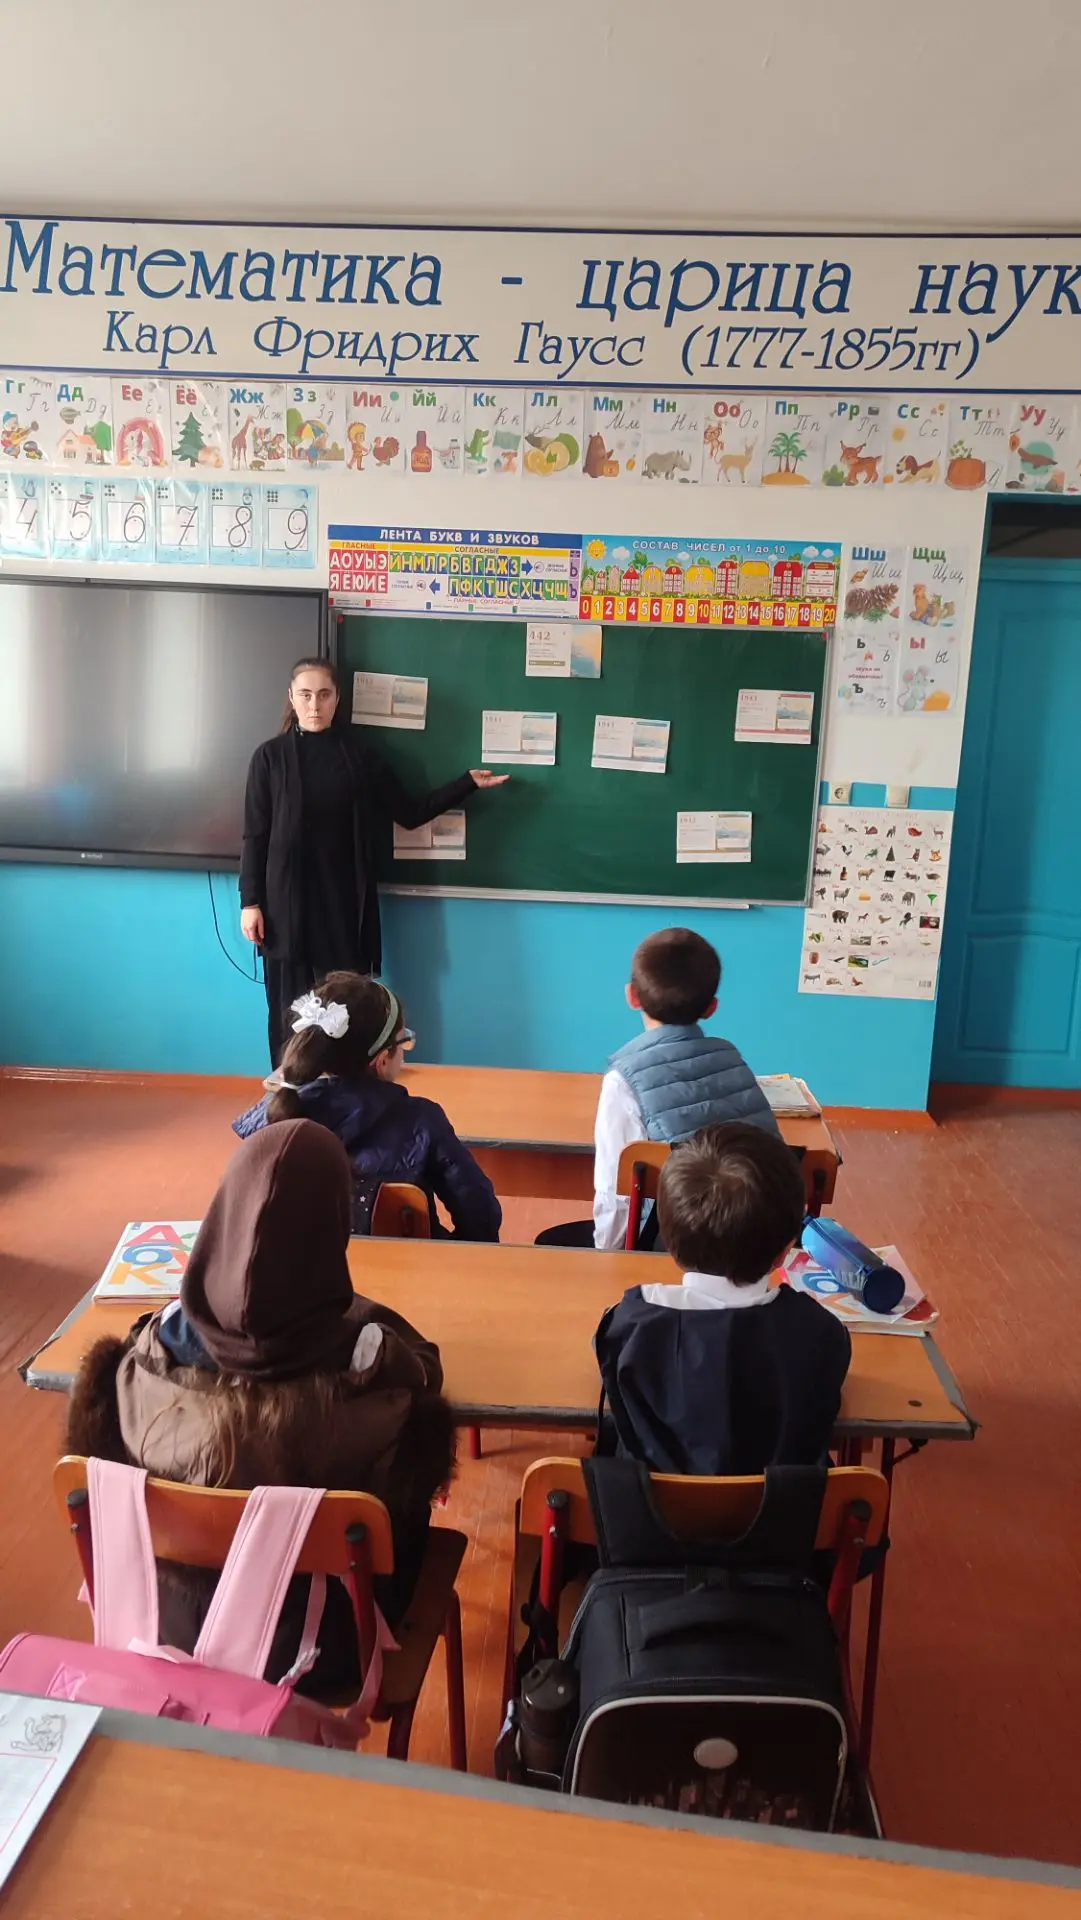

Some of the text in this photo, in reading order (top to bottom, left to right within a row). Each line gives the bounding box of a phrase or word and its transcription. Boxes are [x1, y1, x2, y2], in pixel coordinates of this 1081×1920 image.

[0, 220, 443, 306] Математика
[576, 256, 851, 328] царица
[909, 260, 1081, 343] наук
[103, 310, 980, 380] Карл Фридрих Гаусс (1777-1855гг)
[57, 384, 84, 402] Дд
[122, 385, 143, 401] Ее
[176, 385, 197, 405] Ёё
[230, 389, 265, 403] Жж
[353, 391, 382, 407] Ии
[412, 389, 437, 407] Йй
[473, 392, 496, 407] Кк
[531, 392, 558, 407] Лл
[593, 396, 623, 411] Мм
[653, 398, 677, 413] Нн
[713, 401, 741, 418] Оо
[775, 401, 799, 416] Пп
[837, 402, 860, 421] Рр
[897, 404, 920, 419] Сс
[1020, 405, 1047, 426] Уу
[16, 499, 37, 541] 4
[70, 500, 92, 541] 5
[124, 502, 146, 543] 6
[177, 505, 198, 546] 7
[228, 506, 252, 548] 8
[284, 508, 309, 550] 9
[380, 529, 540, 545] ЛЕНТА БУКВ И ЗВУКОВ
[454, 546, 501, 555] СОГЛАСНЫЕ
[632, 540, 679, 550] СОСТАВ
[686, 542, 726, 552] ЧИСЕЛ
[746, 544, 751, 552] 1
[755, 546, 769, 554] до
[774, 545, 785, 554] 10
[852, 547, 886, 561] Шш
[913, 548, 946, 563] Щщ
[582, 600, 589, 614] 0
[594, 600, 600, 614] 1
[605, 600, 613, 615] 2
[618, 601, 624, 615] 3
[629, 601, 636, 616] 4
[641, 602, 648, 615] 5
[652, 602, 660, 617] 6
[665, 603, 672, 616] 7
[676, 603, 684, 617] 8
[688, 604, 695, 617] 9
[698, 604, 709, 618] 10
[712, 604, 721, 618] 11
[723, 604, 734, 619] 12
[736, 605, 747, 619] 13
[749, 605, 759, 620] 14
[761, 606, 772, 619] 15
[774, 606, 785, 620] 16
[787, 607, 797, 620] 17
[799, 607, 810, 621] 18
[812, 607, 822, 621] 19
[824, 608, 835, 621] 20
